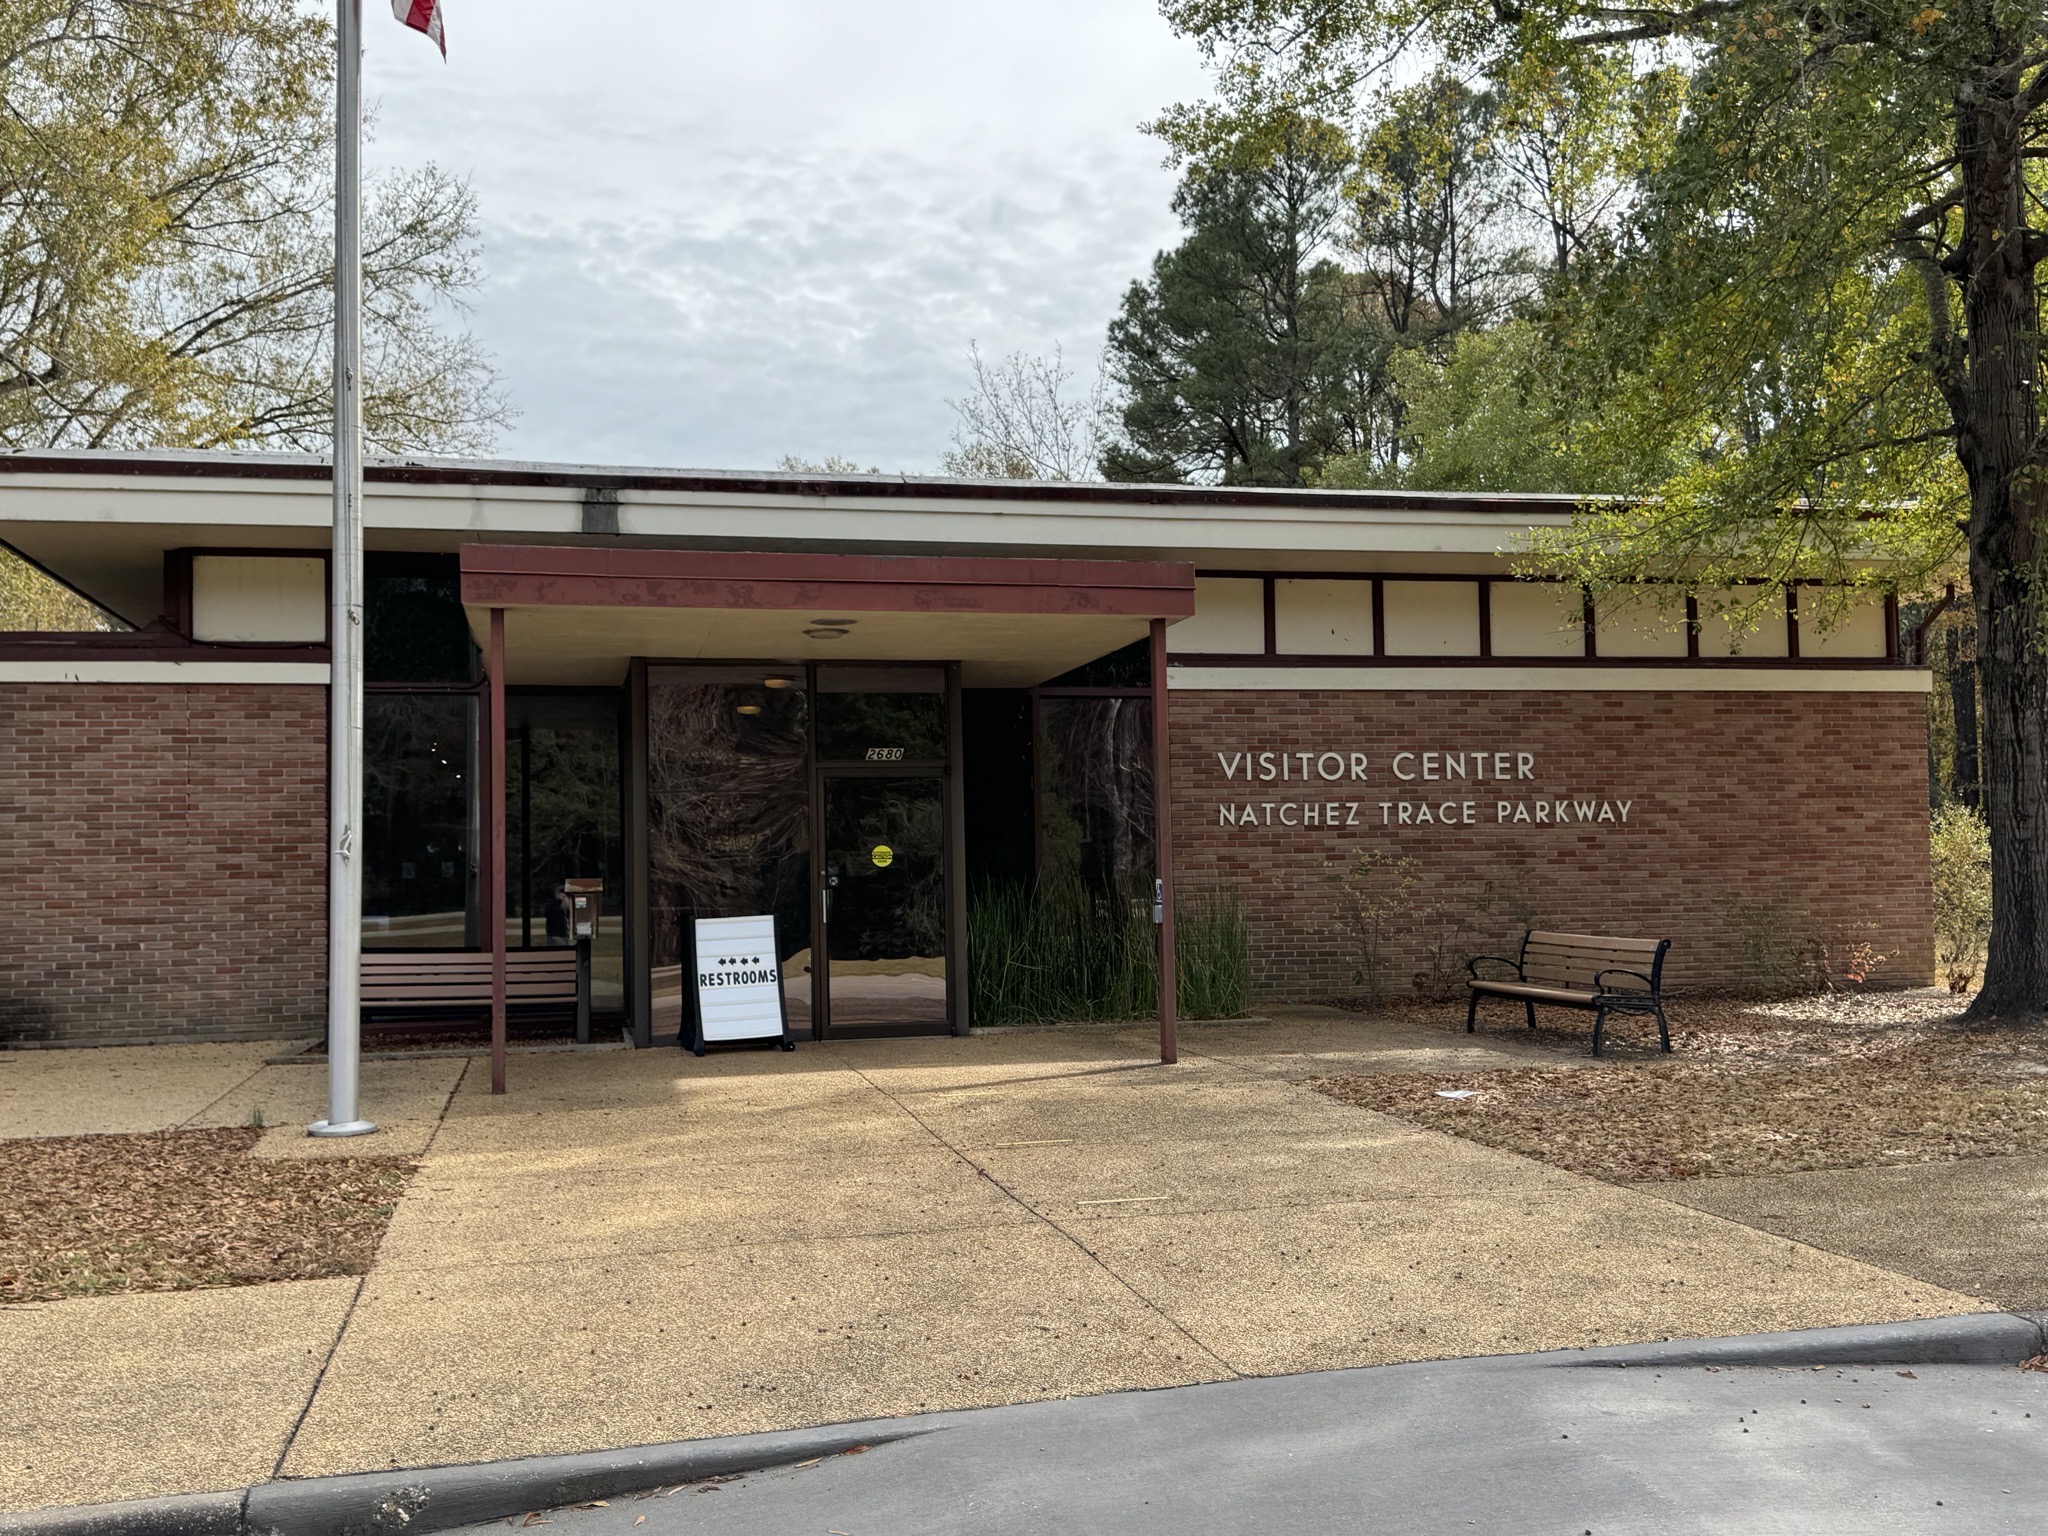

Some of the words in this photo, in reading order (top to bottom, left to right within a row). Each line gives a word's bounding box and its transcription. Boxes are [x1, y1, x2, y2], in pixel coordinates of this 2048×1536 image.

[867, 749, 902, 760] 2680
[1218, 752, 1368, 781] VISITOR
[1392, 752, 1535, 780] CENTER
[1219, 802, 1360, 826] NATCHEZ
[1379, 801, 1476, 825] TRACE
[1497, 800, 1633, 823] PARKWAY
[700, 968, 777, 988] RESTROOMS
